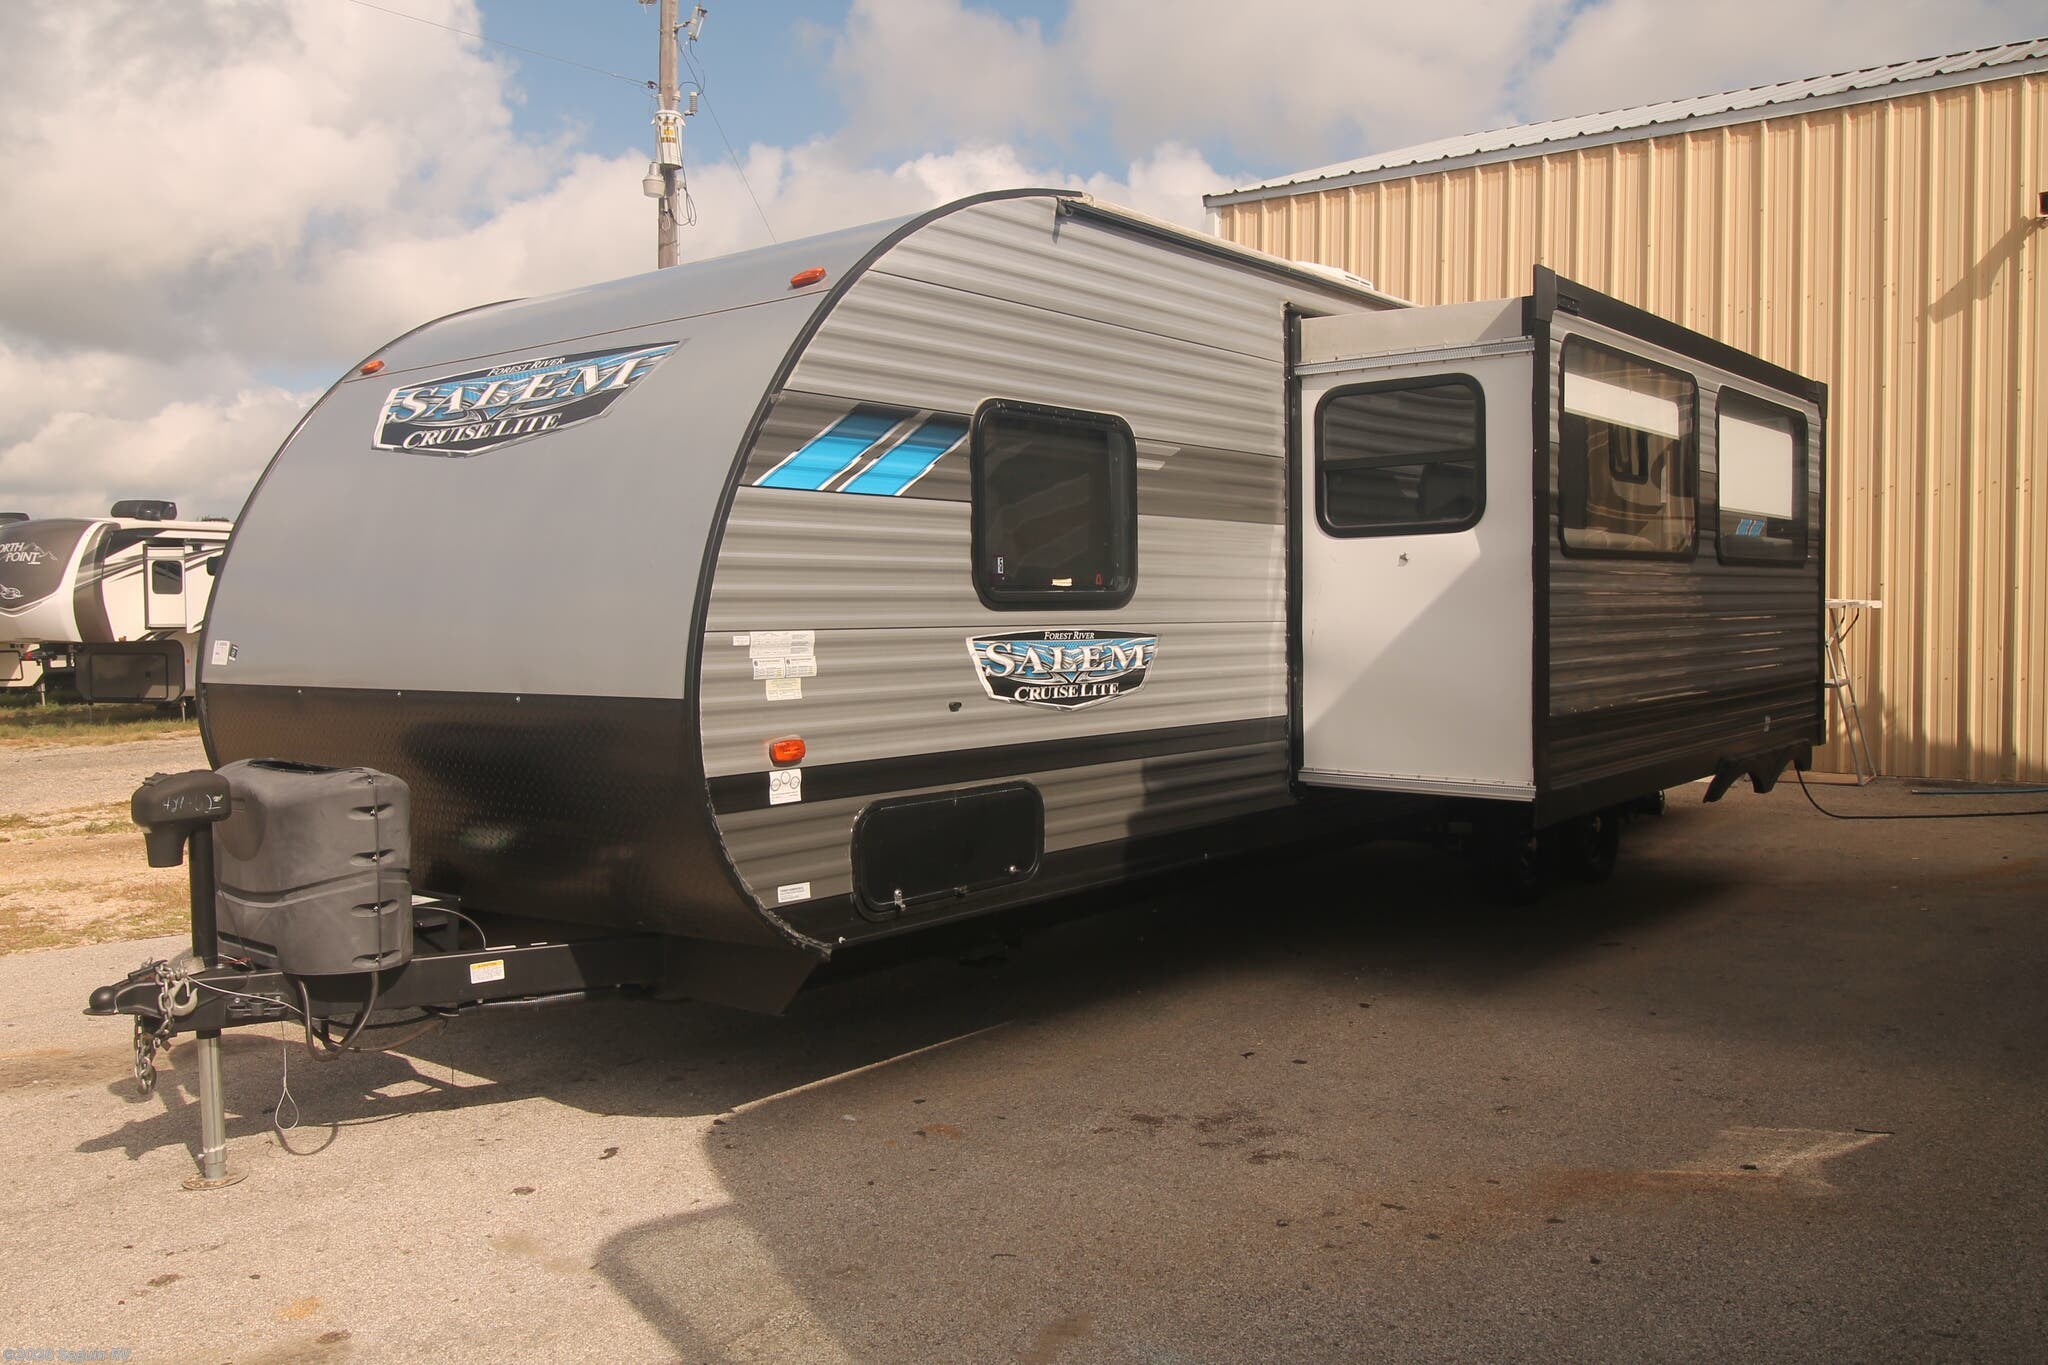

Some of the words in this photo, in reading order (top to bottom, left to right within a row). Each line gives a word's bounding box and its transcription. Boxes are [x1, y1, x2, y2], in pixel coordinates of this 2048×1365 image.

[487, 363, 531, 377] FOREST
[530, 357, 566, 369] RIVER
[387, 357, 648, 423] SALEM
[0, 542, 24, 553] ORTH
[5, 552, 40, 562] POINT
[1044, 631, 1073, 640] FOREST
[1073, 631, 1095, 640] RIVER
[986, 643, 1147, 677] SALEM
